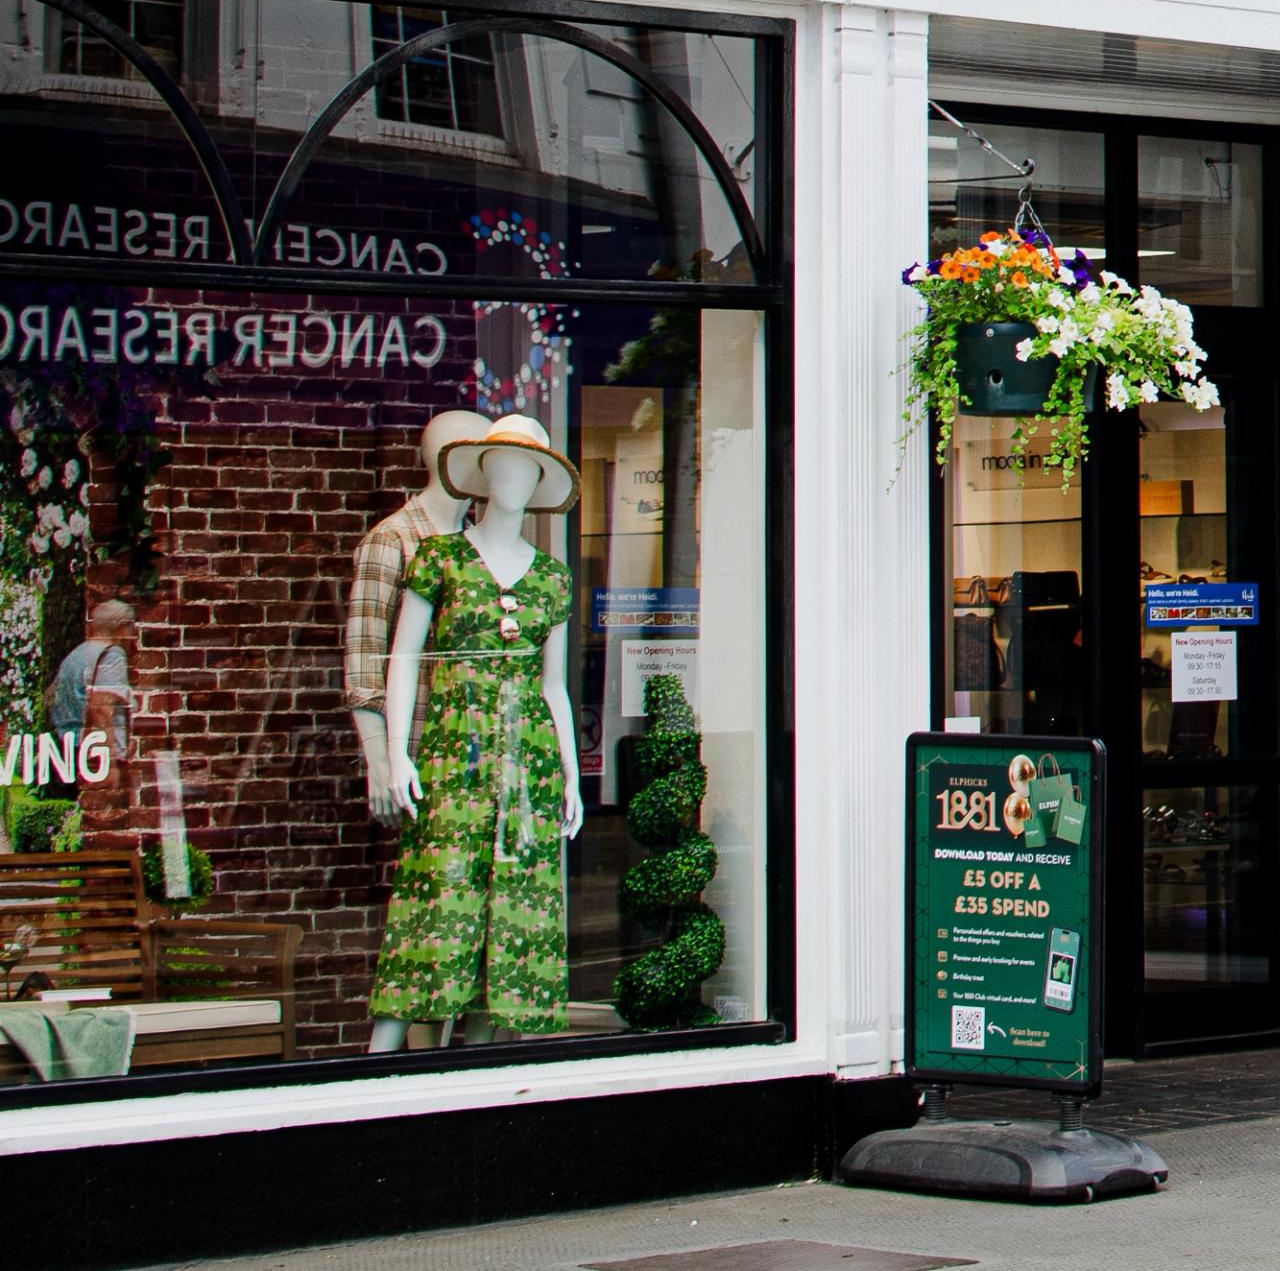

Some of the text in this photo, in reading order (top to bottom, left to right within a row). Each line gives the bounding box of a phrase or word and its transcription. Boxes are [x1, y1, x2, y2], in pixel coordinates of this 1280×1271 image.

[1189, 639, 1214, 647] Opening
[627, 646, 697, 657] New Opening Hours
[636, 661, 663, 672] Monday
[949, 777, 988, 787] ELPHICKS
[936, 789, 1001, 832] 1881
[934, 848, 1071, 866] DOWNLOAD TODAY AND RECEIVE
[963, 869, 1041, 890] £5 OFF A
[954, 895, 1050, 919] £35 SPEND
